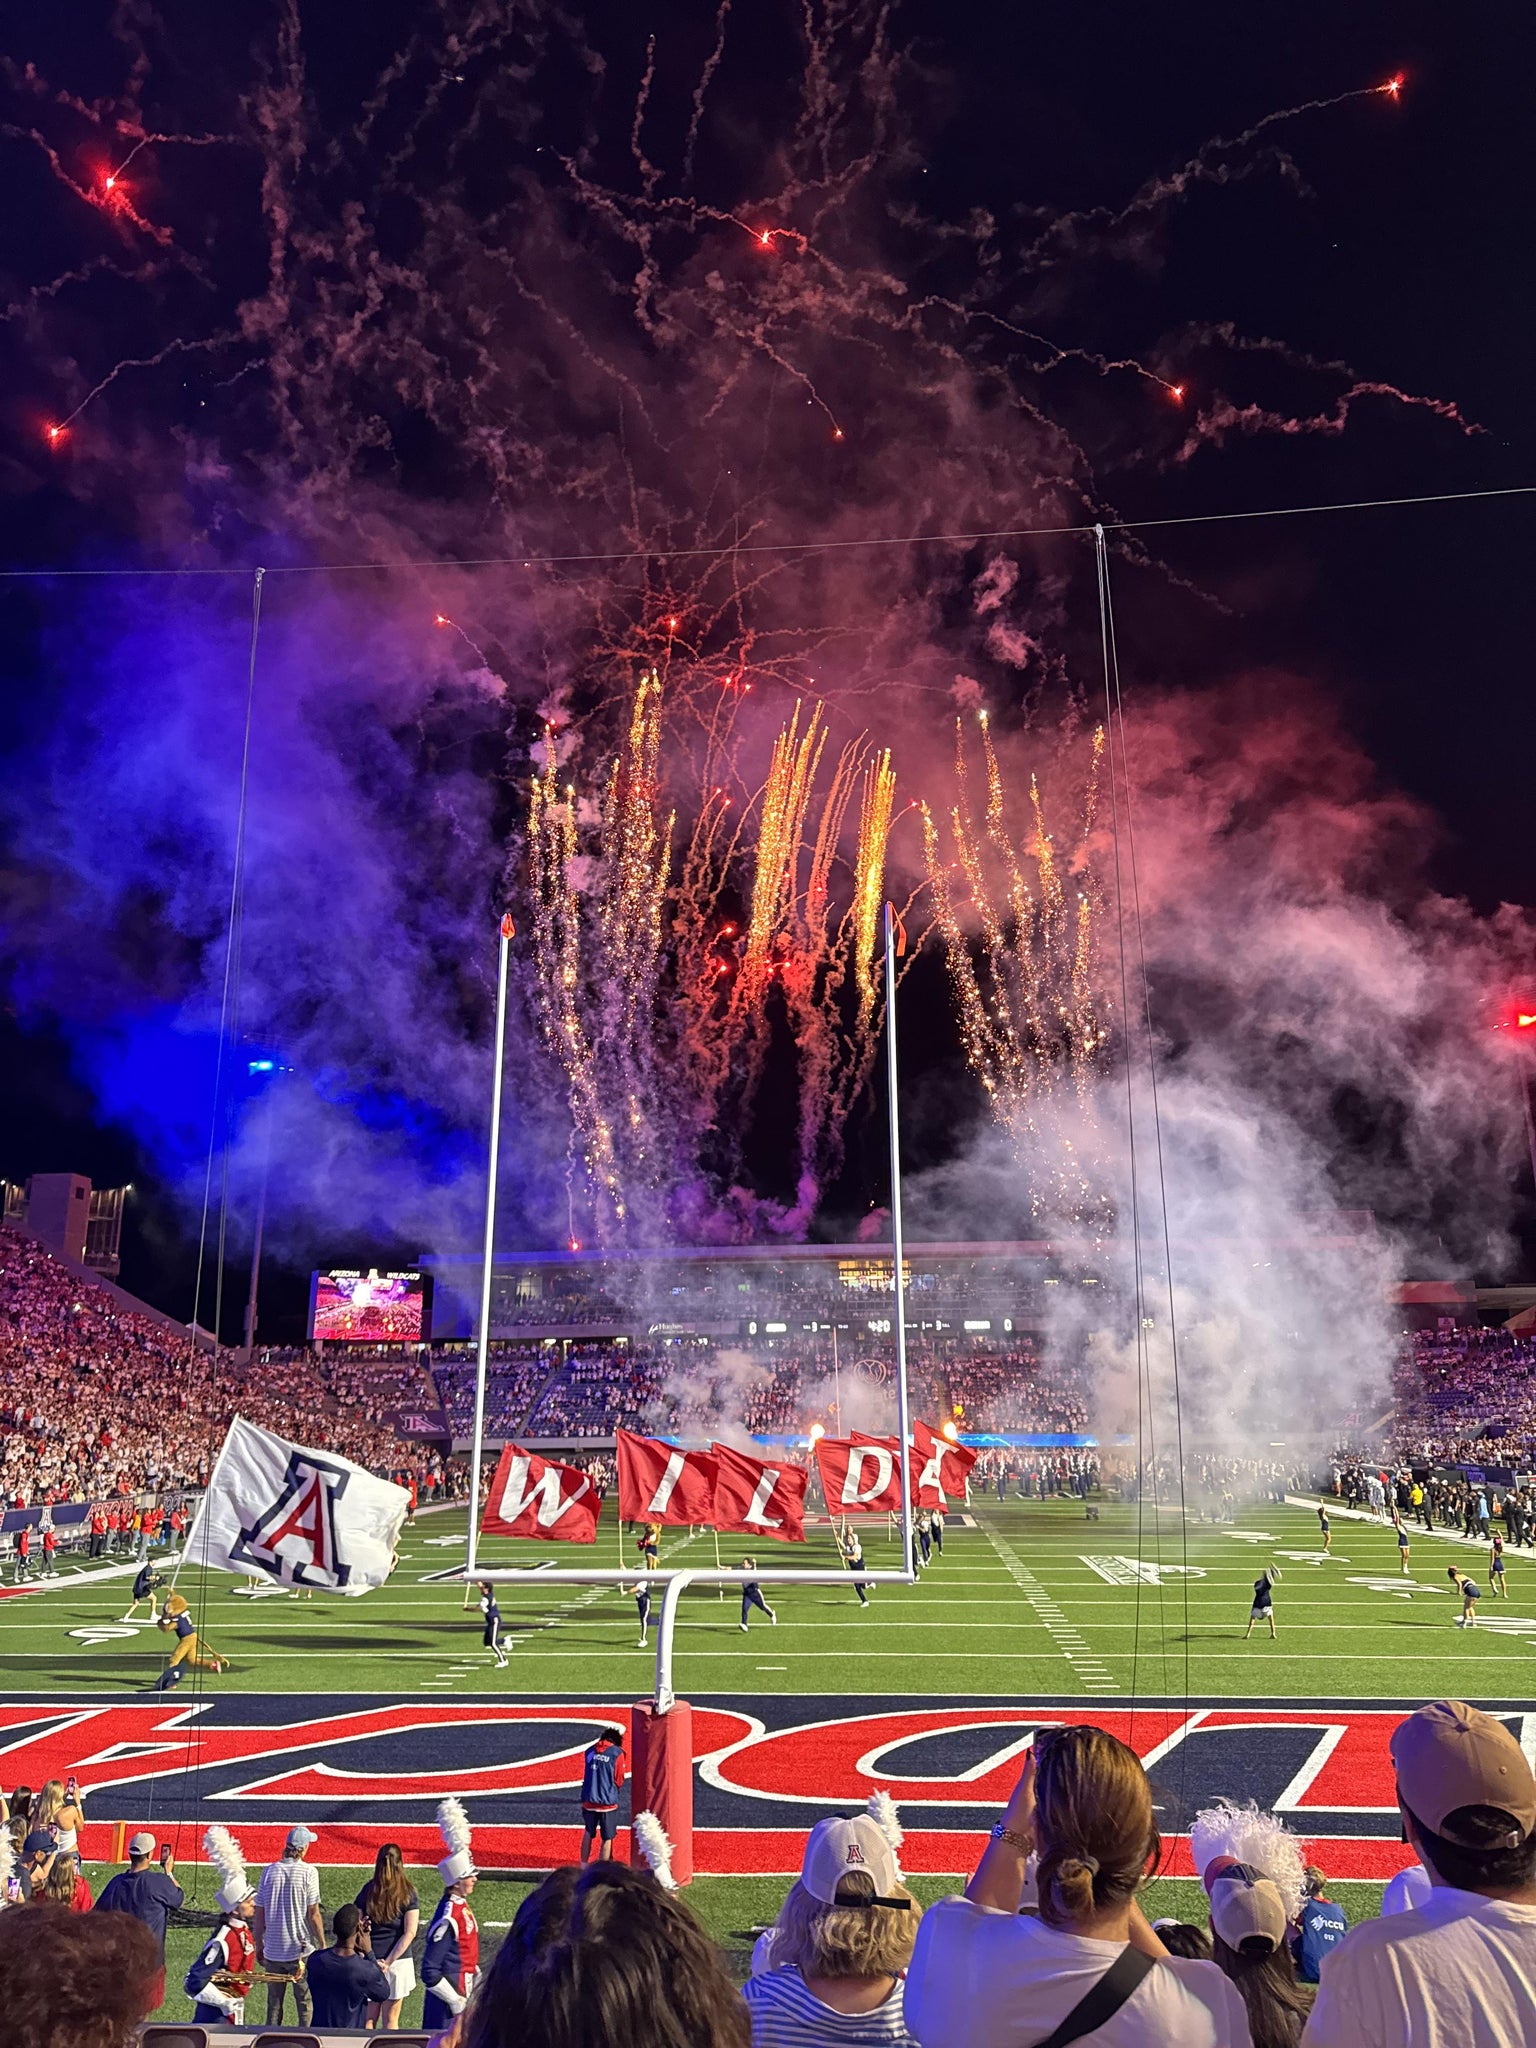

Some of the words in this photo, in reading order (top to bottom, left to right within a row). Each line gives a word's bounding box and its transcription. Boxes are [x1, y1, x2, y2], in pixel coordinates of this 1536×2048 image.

[329, 1270, 360, 1278] ARIZONA
[387, 1272, 420, 1280] WILDCATS
[659, 1323, 683, 1331] Hughes
[868, 1320, 891, 1333] 4:20
[1142, 1318, 1155, 1328] 25
[648, 1452, 686, 1513] I
[841, 1446, 893, 1504] D
[499, 1456, 591, 1528] W
[743, 1467, 781, 1528] L
[229, 1451, 352, 1588] A
[846, 1845, 864, 1863] A
[1324, 1920, 1345, 1931] ICCU
